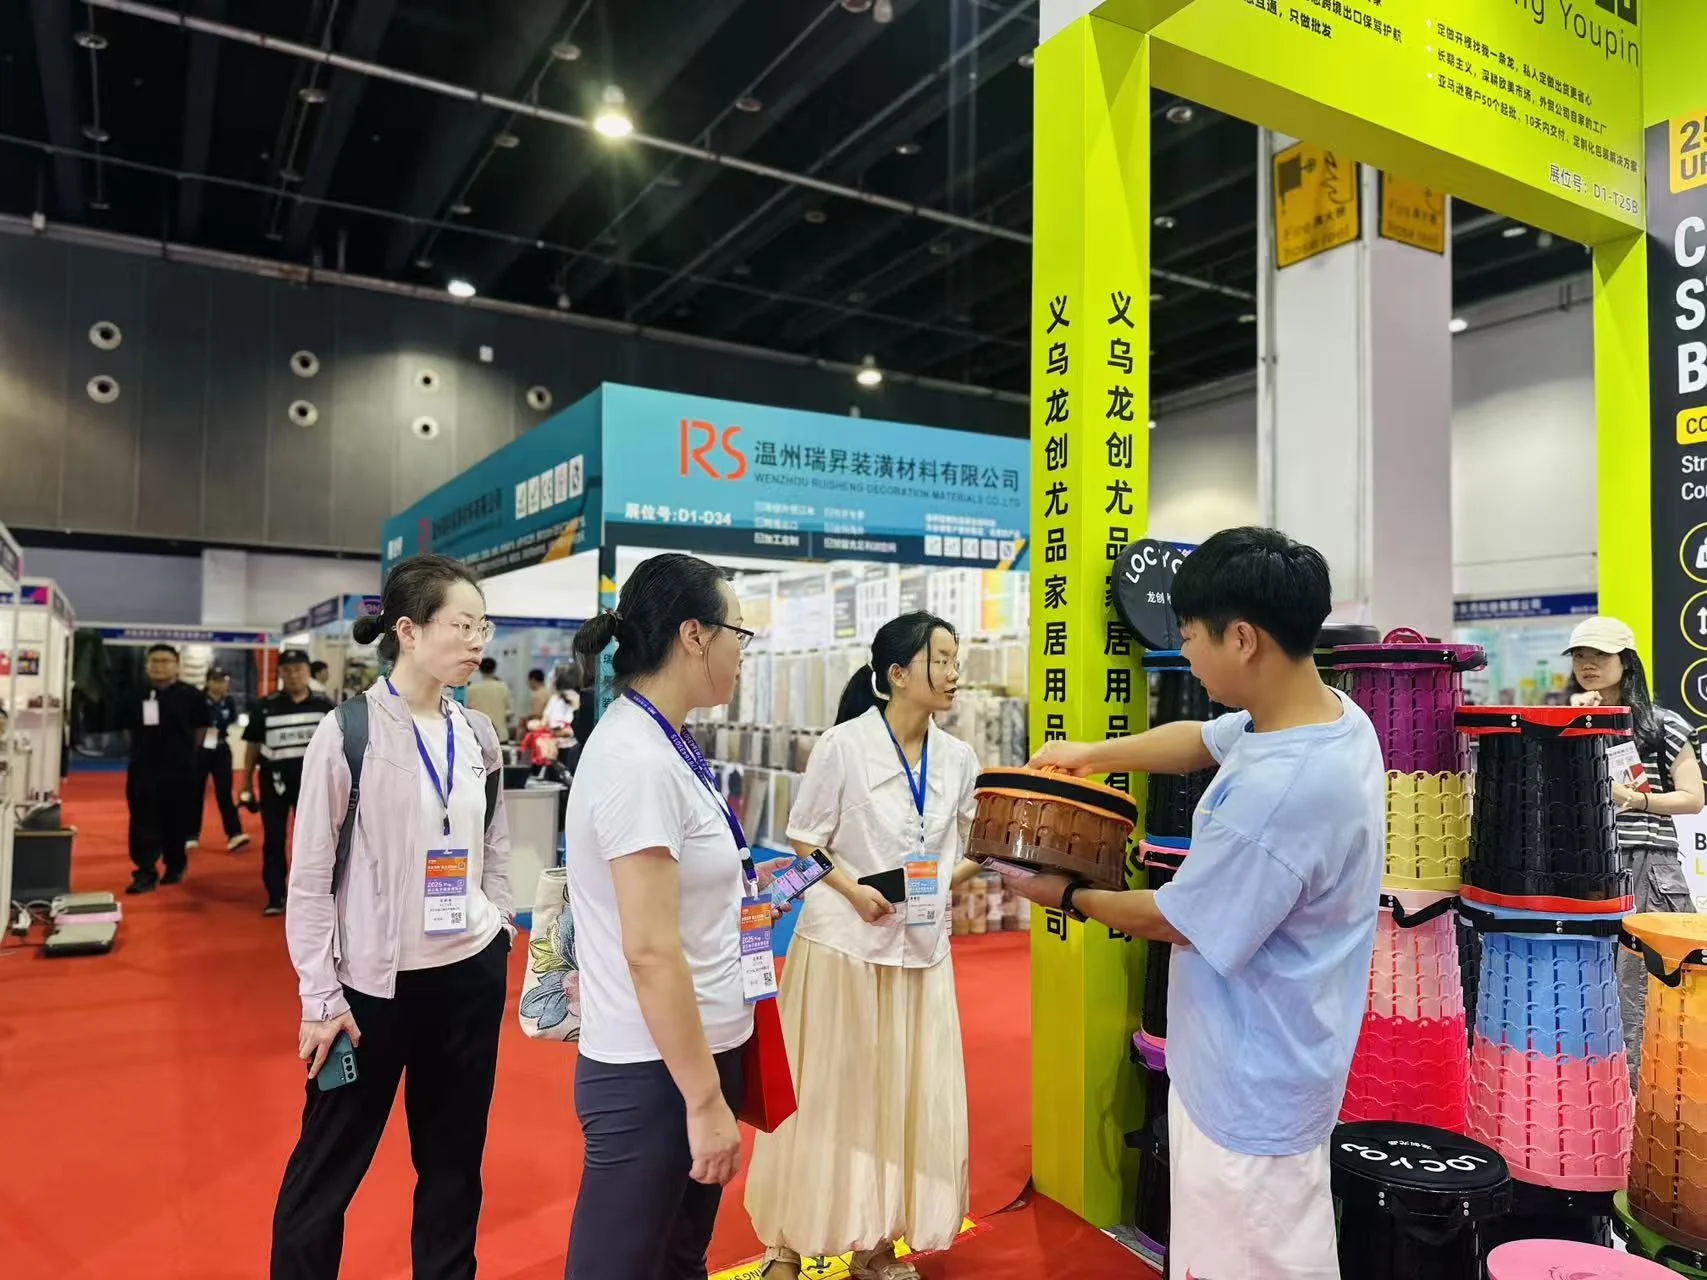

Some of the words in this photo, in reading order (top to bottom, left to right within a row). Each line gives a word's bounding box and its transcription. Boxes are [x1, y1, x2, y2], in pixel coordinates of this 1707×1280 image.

[1559, 0, 1638, 67] Youpin
[1680, 115, 1707, 153] 2
[1675, 276, 1707, 331] S
[679, 418, 747, 481] RS
[754, 473, 809, 488] WENZHOU
[811, 478, 864, 494] RUISHENG
[866, 483, 929, 500] DECORATION
[1681, 482, 1707, 501] Co
[1043, 294, 1071, 942] 义乌龙创尤品家居用品司
